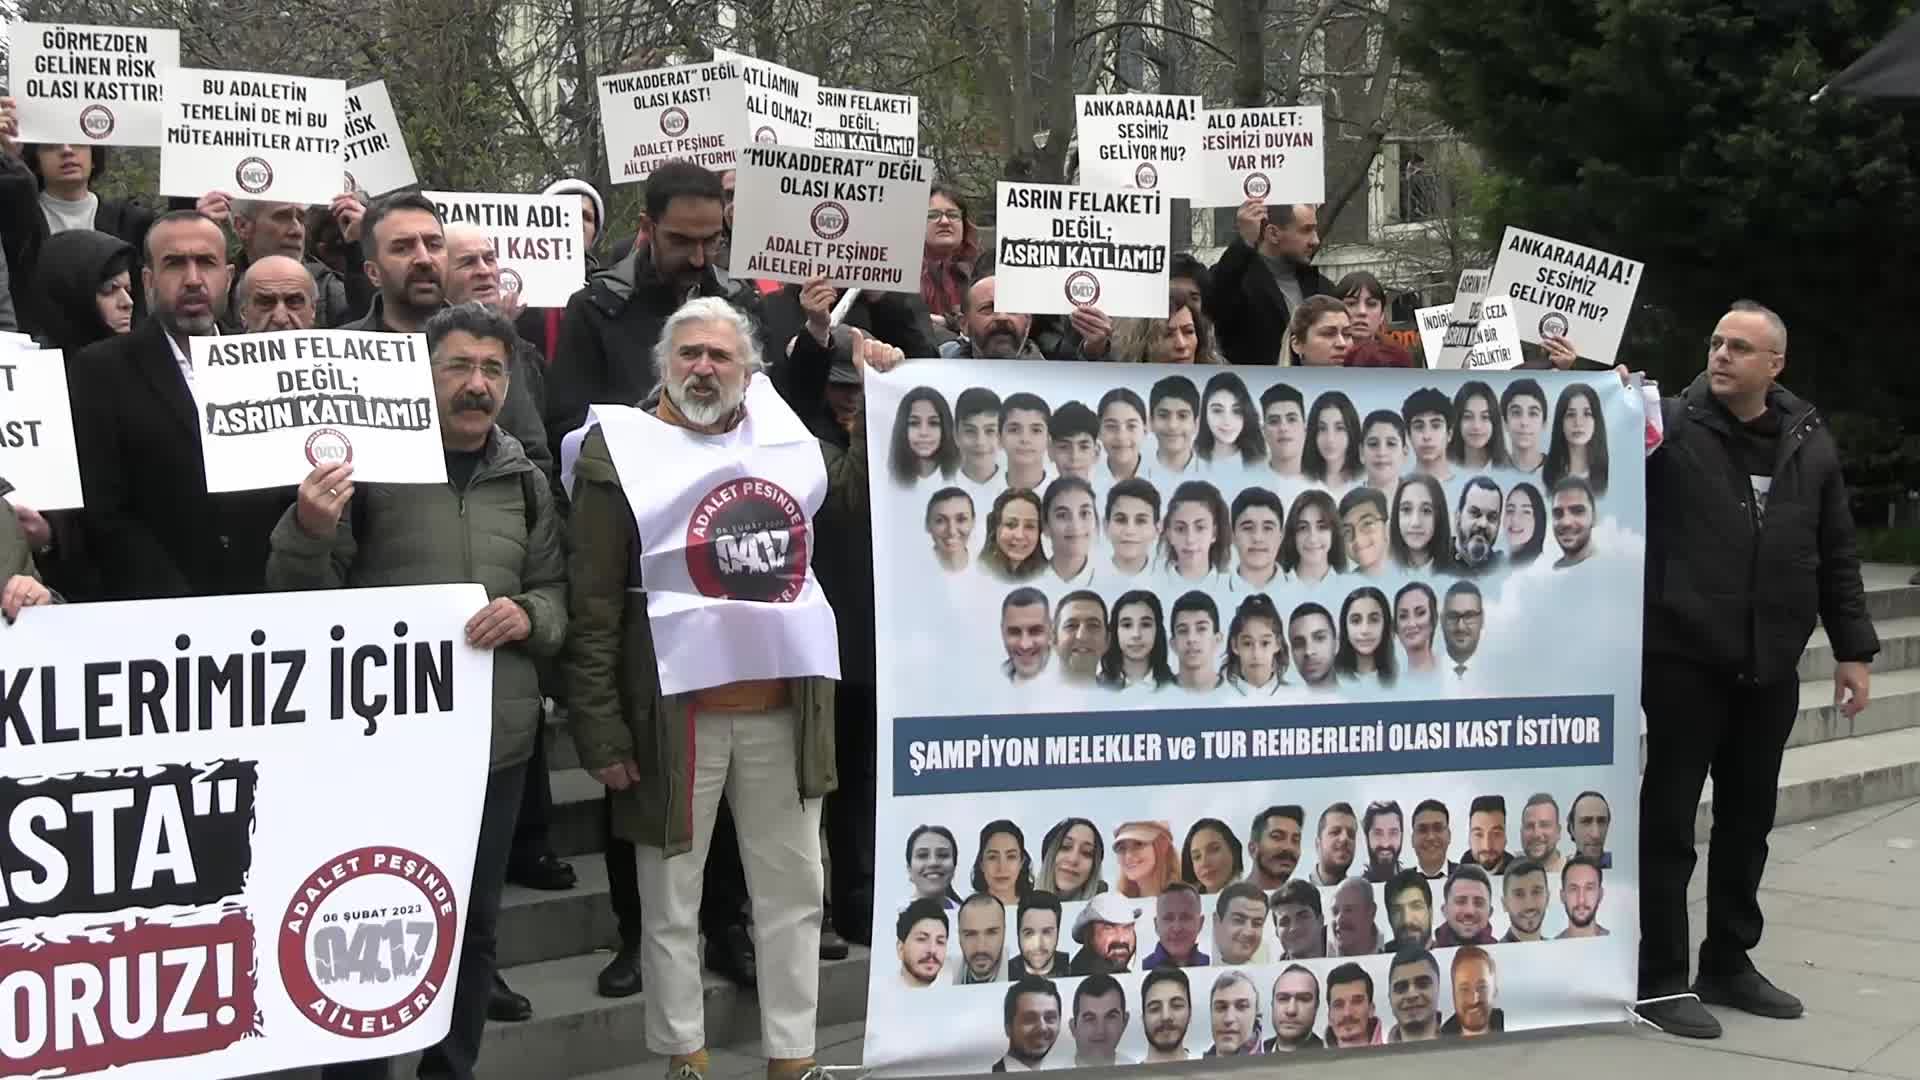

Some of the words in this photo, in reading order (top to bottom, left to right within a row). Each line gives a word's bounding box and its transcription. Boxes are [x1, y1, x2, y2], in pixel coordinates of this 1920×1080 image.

[43, 26, 148, 54] GÖRMEZDEN
[35, 51, 111, 76] GELİNEN
[116, 53, 156, 78] RİSK
[602, 68, 698, 95] “MUKADDERAT”
[702, 61, 739, 82] DEĞİL
[26, 79, 79, 99] OLASI
[84, 81, 163, 102] KASTTIR!
[203, 80, 223, 95] BU
[230, 79, 307, 102] ADALETİN
[743, 67, 799, 98] ATLİAMIN
[633, 92, 669, 110] OLASI
[672, 87, 711, 105] KAST!
[817, 91, 846, 107] SRIN
[850, 94, 911, 115] FELAKETİ
[1084, 98, 1196, 121] ANKARAAAAA!
[181, 103, 257, 122] TEMELİNİ
[262, 108, 281, 125] DE
[286, 107, 303, 126] Mİ
[308, 114, 327, 129] BU
[771, 101, 812, 129] OLMAZ!
[839, 113, 880, 132] DEĞİL;
[1207, 113, 1236, 130] ALO
[1240, 111, 1303, 128] ADALET:
[167, 126, 291, 151] MÜTEAHHİTLER
[297, 136, 340, 154] ATTI?
[814, 131, 846, 149] SRIN
[1118, 119, 1168, 140] SESİMİZ
[1265, 132, 1313, 148] DUYAN
[633, 140, 673, 158] ADALET
[677, 133, 725, 153] PEŞİNDE
[1099, 140, 1157, 161] GELİYOR
[1160, 145, 1186, 162] MU?
[624, 157, 672, 176] AİLEL
[743, 148, 873, 176] “MUKADDERAT”
[878, 159, 926, 183] DEĞİL
[1228, 155, 1256, 170] VAR
[1261, 154, 1285, 169] MI?
[780, 176, 829, 199] OLASI
[834, 182, 884, 204] KAST!
[1007, 187, 1063, 211] ASRIN
[1067, 190, 1161, 215] FELAKETİ
[525, 203, 571, 228] ADI:
[1051, 214, 1113, 241] DEĞİL;
[507, 236, 573, 261] KAST!
[766, 236, 822, 257] ADALET
[827, 241, 888, 264] PEŞİNDE
[1002, 243, 1061, 266] ASRIN
[1508, 234, 1635, 286] ANKARAAAAA!
[748, 255, 811, 277] AİLELERİ
[817, 263, 902, 284] PLATFORMU
[1536, 265, 1598, 298] SESİMİZ
[1508, 281, 1576, 320] GELİYOR
[1578, 299, 1609, 322] MU?
[1422, 308, 1452, 331] İNDİRİ
[1485, 303, 1508, 321] CEZA
[1483, 324, 1499, 342] BİR
[207, 340, 286, 367] ASRIN
[294, 334, 417, 364] FELAKETİ
[277, 362, 360, 394] DEĞİL;
[211, 402, 295, 433] ASRIN
[693, 484, 739, 538] ADALET
[330, 621, 455, 737] İÇİN
[909, 734, 1040, 776] ŞAMPİYON
[1045, 733, 1162, 765] MELEKLER
[1167, 735, 1196, 761] ve
[1201, 729, 1247, 758] TUR
[1252, 719, 1384, 757] REHBERLERİ
[1388, 721, 1451, 751] OLASI
[1456, 719, 1512, 748] KAST
[1516, 713, 1601, 746] İSTİYOR
[0, 778, 238, 908] STA"
[288, 857, 361, 935] ADALET
[374, 853, 453, 916] PEŞİNDE
[323, 912, 339, 923] 06
[343, 907, 388, 923] ŞUBAT
[392, 904, 423, 917] 2023
[0, 942, 236, 1060] ORUZ!
